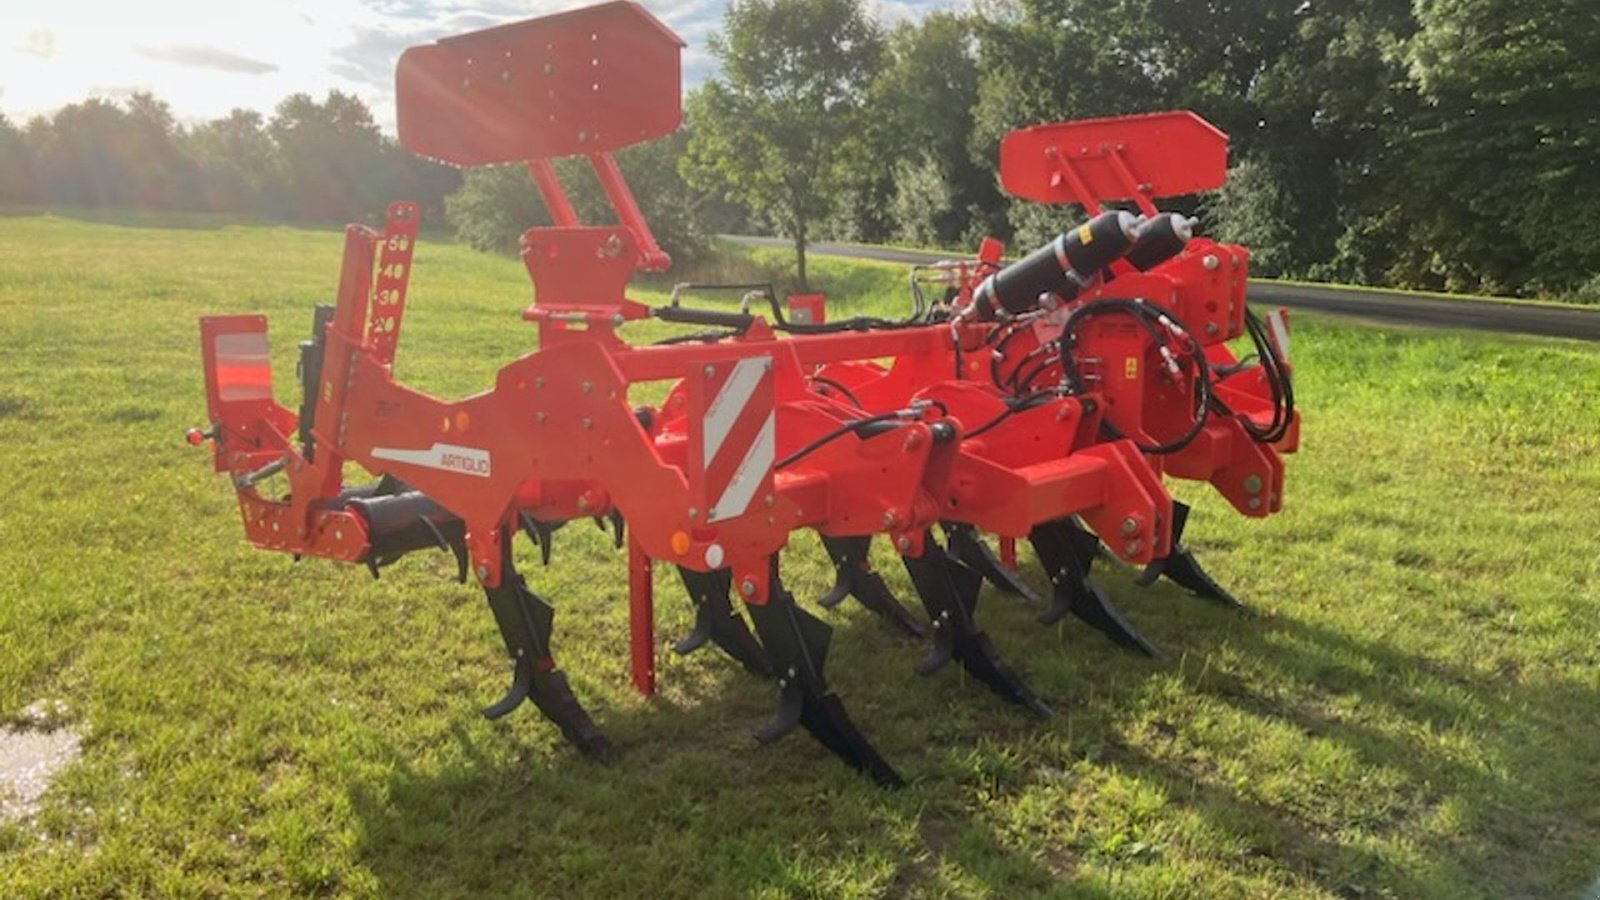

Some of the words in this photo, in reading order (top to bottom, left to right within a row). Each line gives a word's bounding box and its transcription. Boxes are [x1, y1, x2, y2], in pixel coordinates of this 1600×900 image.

[388, 234, 408, 251] 50
[383, 264, 403, 279] 40
[378, 289, 399, 305] 30
[374, 316, 394, 333] 20
[440, 453, 488, 473] ARTIGLIO
